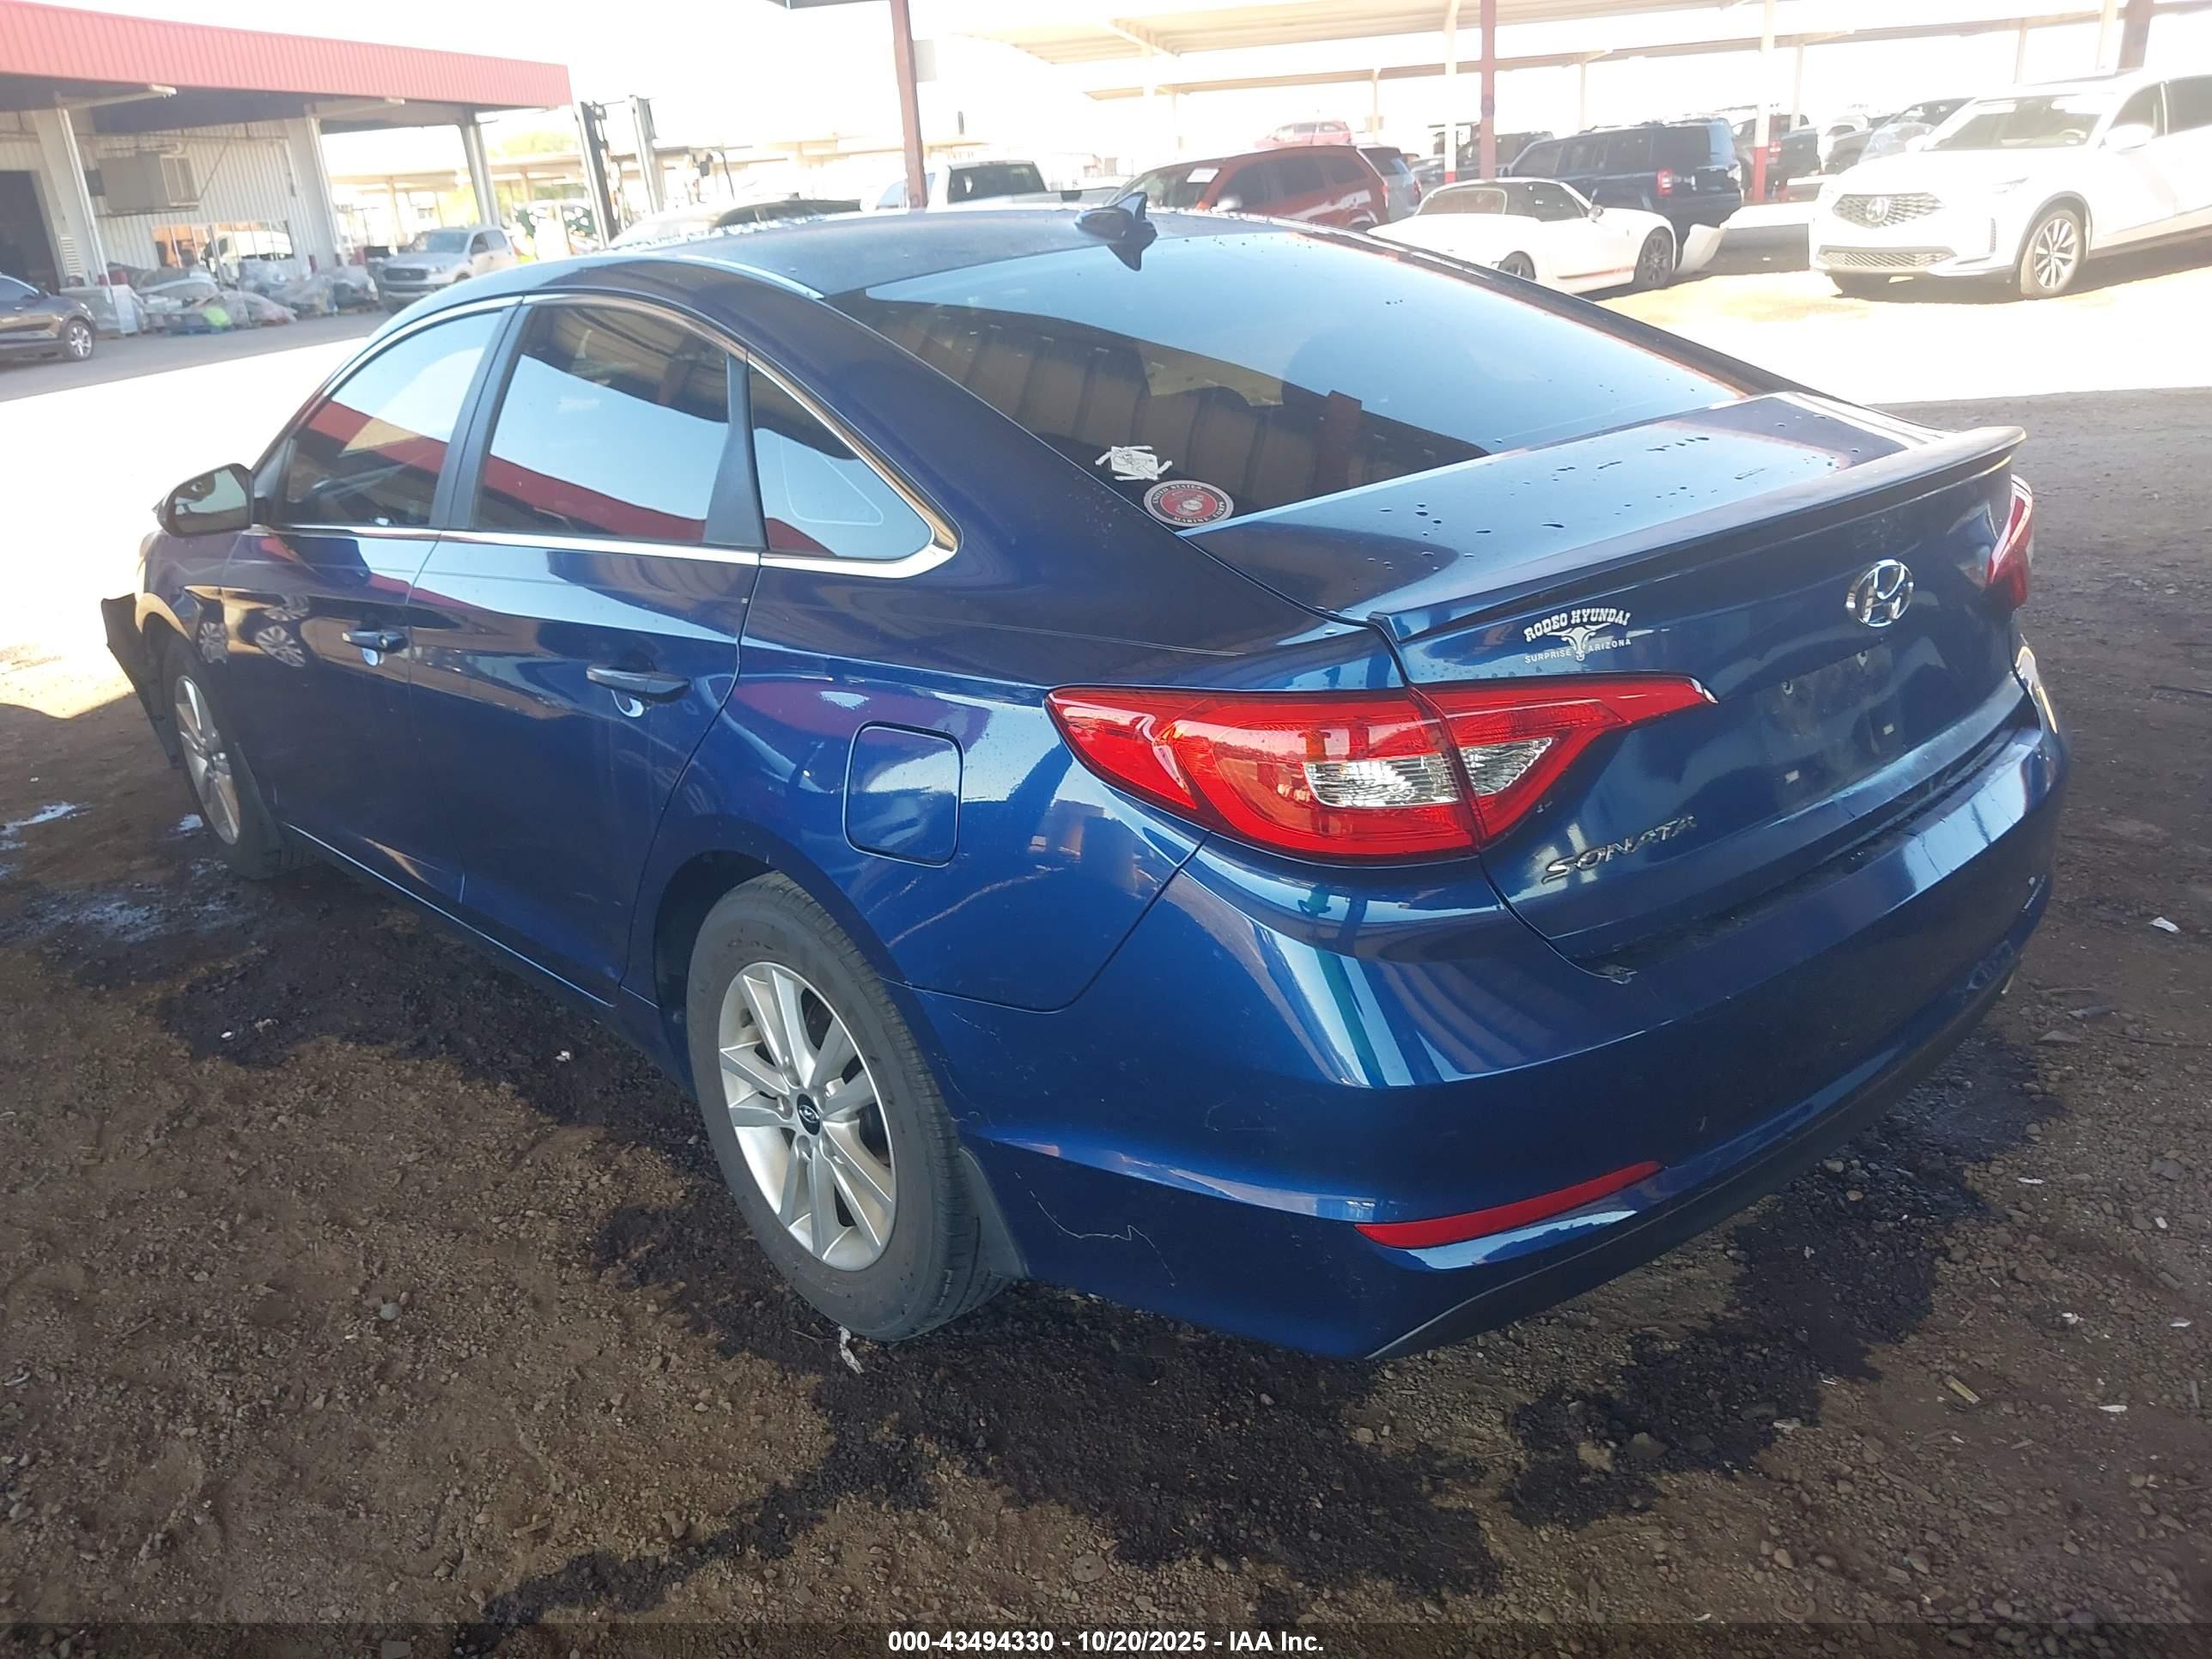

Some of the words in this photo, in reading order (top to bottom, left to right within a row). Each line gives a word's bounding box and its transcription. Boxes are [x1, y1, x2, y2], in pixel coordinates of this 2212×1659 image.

[1523, 612, 1568, 642] RODEO
[1571, 608, 1631, 626] HYUNDAI
[1524, 649, 1571, 664] SURPRISE
[1588, 638, 1632, 653] ARIZONA
[1541, 815, 1697, 884] SONATA
